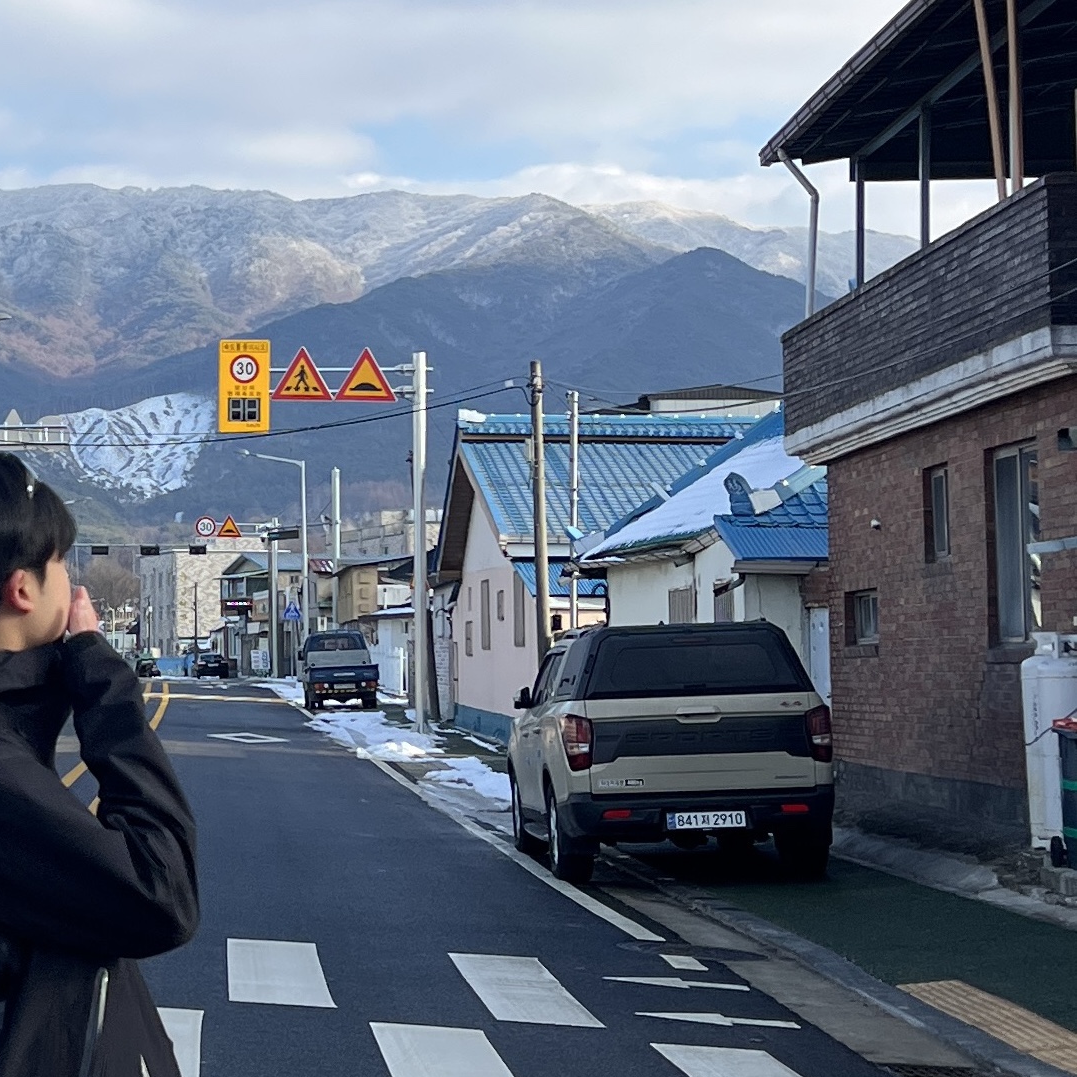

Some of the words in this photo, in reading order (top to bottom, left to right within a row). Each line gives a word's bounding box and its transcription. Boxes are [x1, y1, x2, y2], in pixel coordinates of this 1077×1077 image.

[236, 362, 254, 375] 30
[199, 522, 212, 532] 30
[625, 729, 773, 744] SPORTS
[712, 812, 743, 826] 2910
